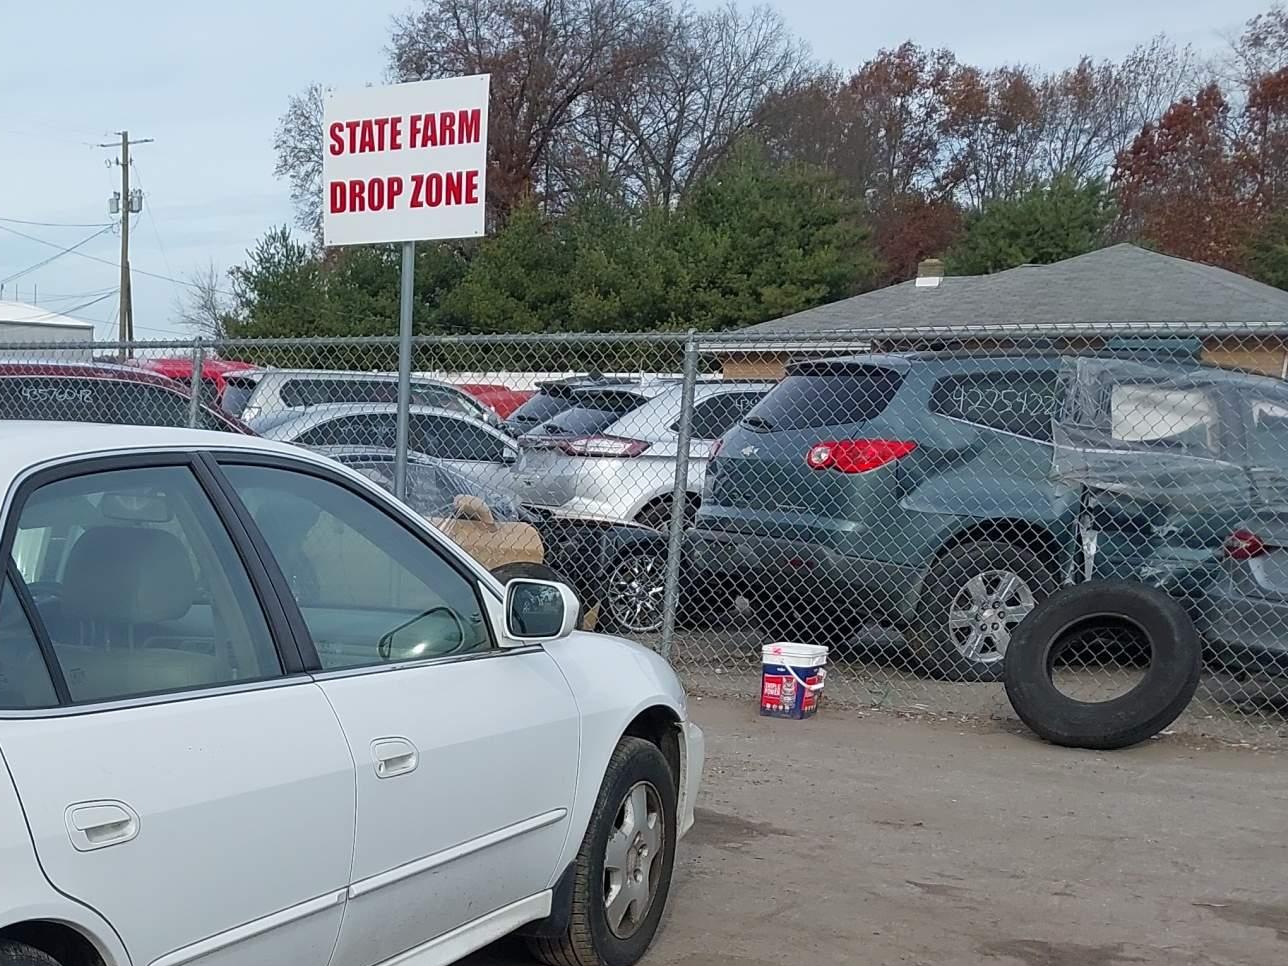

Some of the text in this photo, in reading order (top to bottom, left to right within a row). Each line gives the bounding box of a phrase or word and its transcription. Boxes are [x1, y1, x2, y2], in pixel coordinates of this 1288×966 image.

[329, 109, 481, 156] STATE FARM
[330, 170, 479, 214] DROP ZONE
